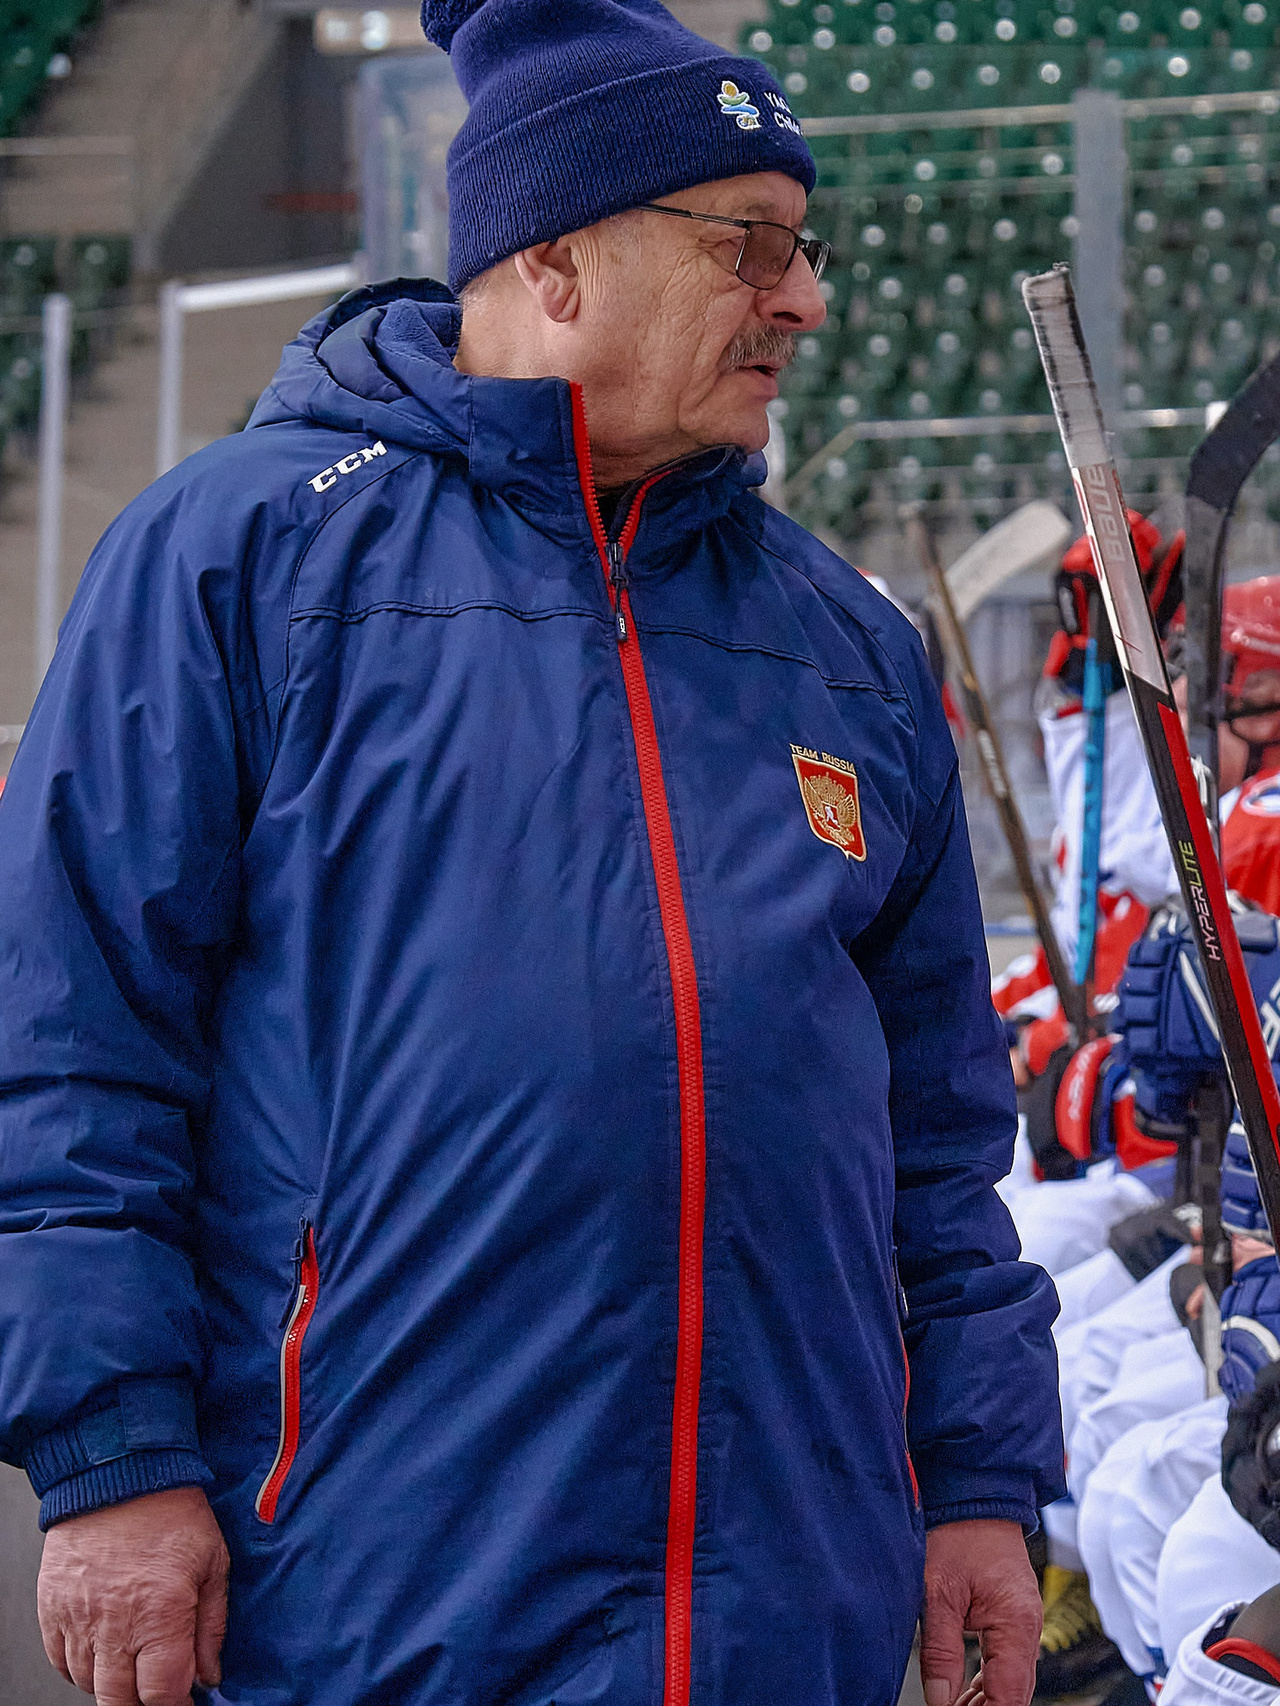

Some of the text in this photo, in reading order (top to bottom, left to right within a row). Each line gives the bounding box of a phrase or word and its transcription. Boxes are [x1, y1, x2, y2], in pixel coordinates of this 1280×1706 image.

[307, 440, 388, 493] CCM
[789, 742, 856, 774] TEAM RUSSIA
[1179, 840, 1221, 961] HYPERLITE
